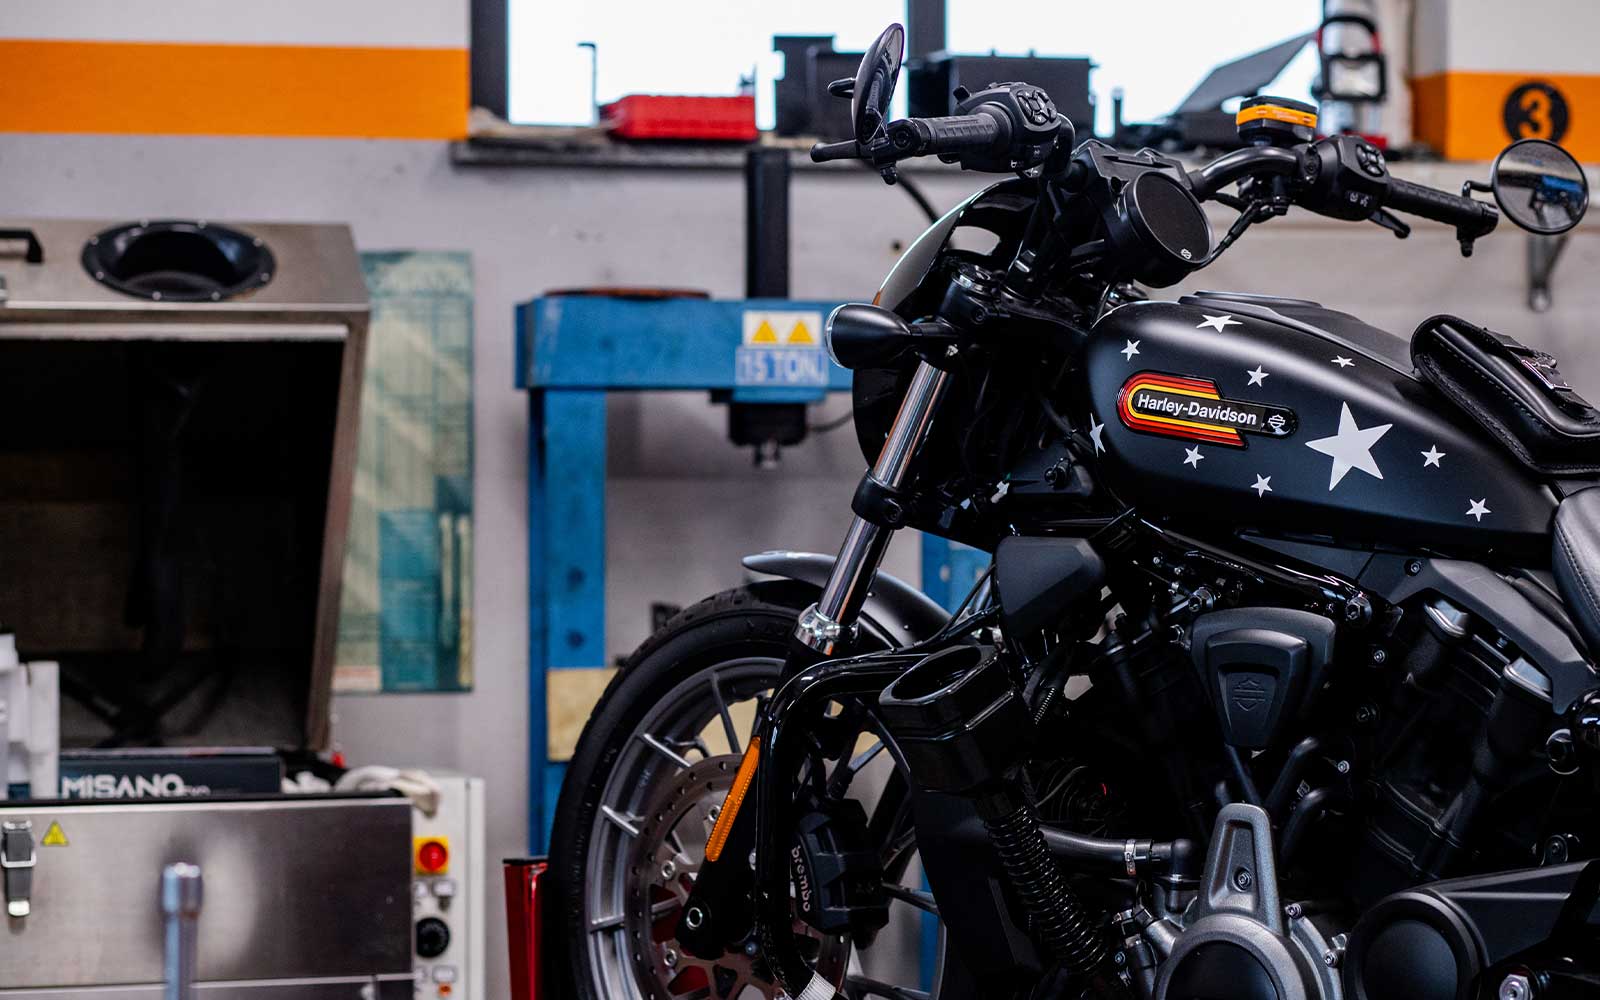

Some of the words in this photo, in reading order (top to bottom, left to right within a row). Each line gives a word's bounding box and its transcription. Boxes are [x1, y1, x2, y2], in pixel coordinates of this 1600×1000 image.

[1520, 88, 1552, 139] 3
[1137, 393, 1257, 426] Harley-Davidson
[61, 774, 184, 799] MISANO
